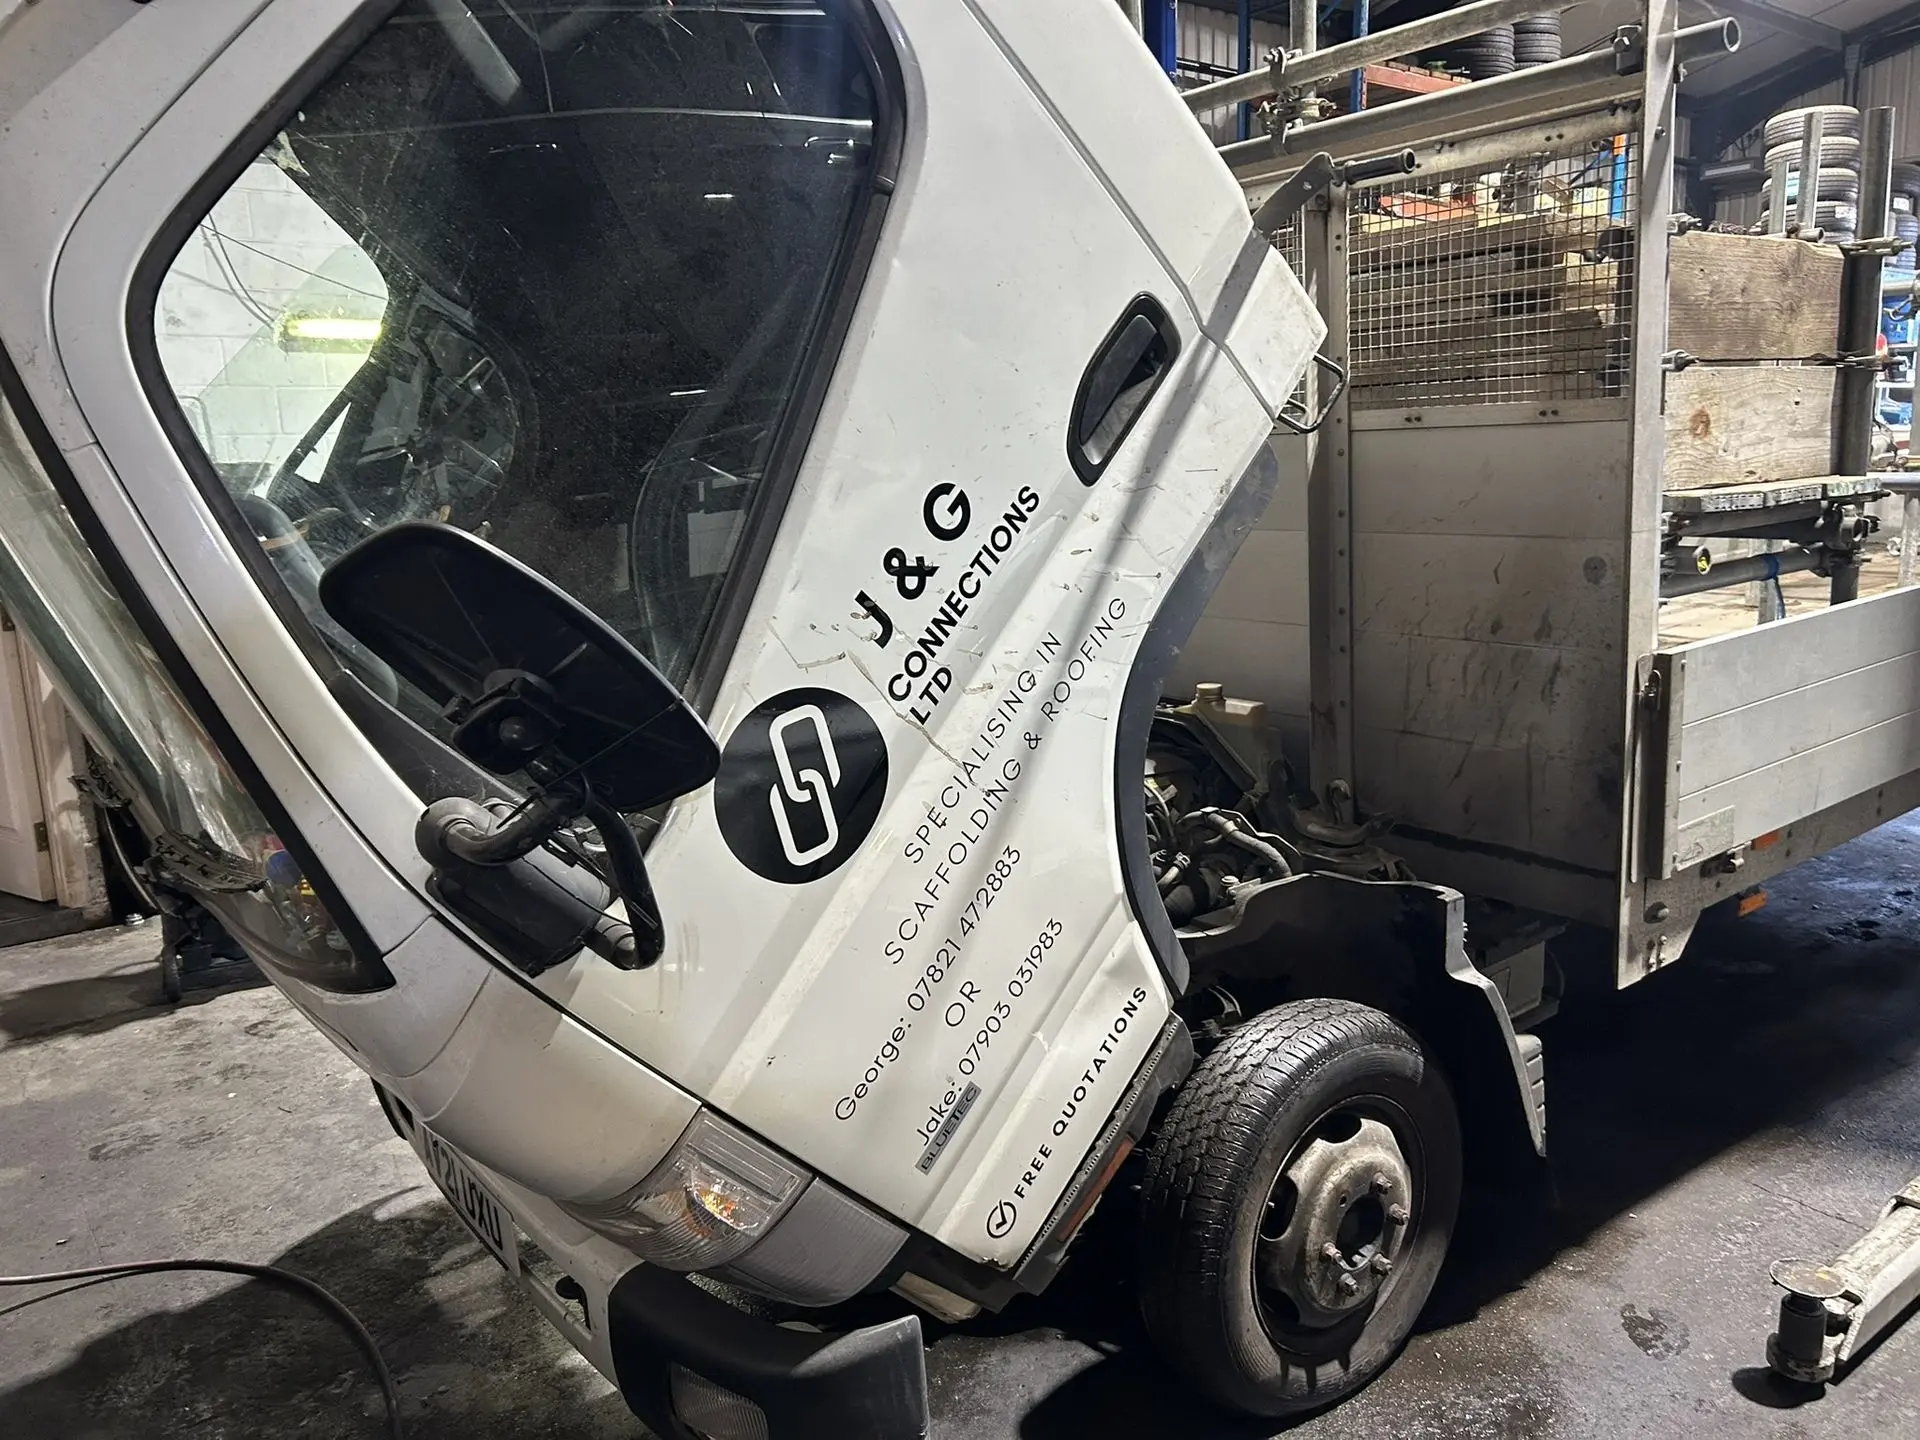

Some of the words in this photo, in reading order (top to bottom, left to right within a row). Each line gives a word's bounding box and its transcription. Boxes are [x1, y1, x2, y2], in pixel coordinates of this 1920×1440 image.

[853, 590, 894, 648] J
[883, 547, 940, 601] &
[923, 481, 972, 542] G
[887, 485, 1040, 703] CONNECTIONS
[884, 758, 1021, 966] SCAFFOLDING
[1023, 731, 1043, 751] &
[1041, 597, 1127, 722] ROOFING
[904, 668, 1037, 865] SPECIALISING
[1037, 631, 1063, 664] IN
[907, 666, 953, 727] LTD
[834, 1017, 912, 1121] George:
[906, 938, 962, 1013] 07821
[959, 847, 1022, 937] 472883
[917, 1081, 964, 1147] Jake:
[958, 1000, 1012, 1076] 07903
[1007, 917, 1063, 998] 031983
[944, 980, 982, 1028] OR
[920, 1084, 981, 1171] BLUETEC
[1013, 1143, 1053, 1201] FREE
[1053, 985, 1147, 1136] QUOTATIONS
[460, 1169, 504, 1252] UXU
